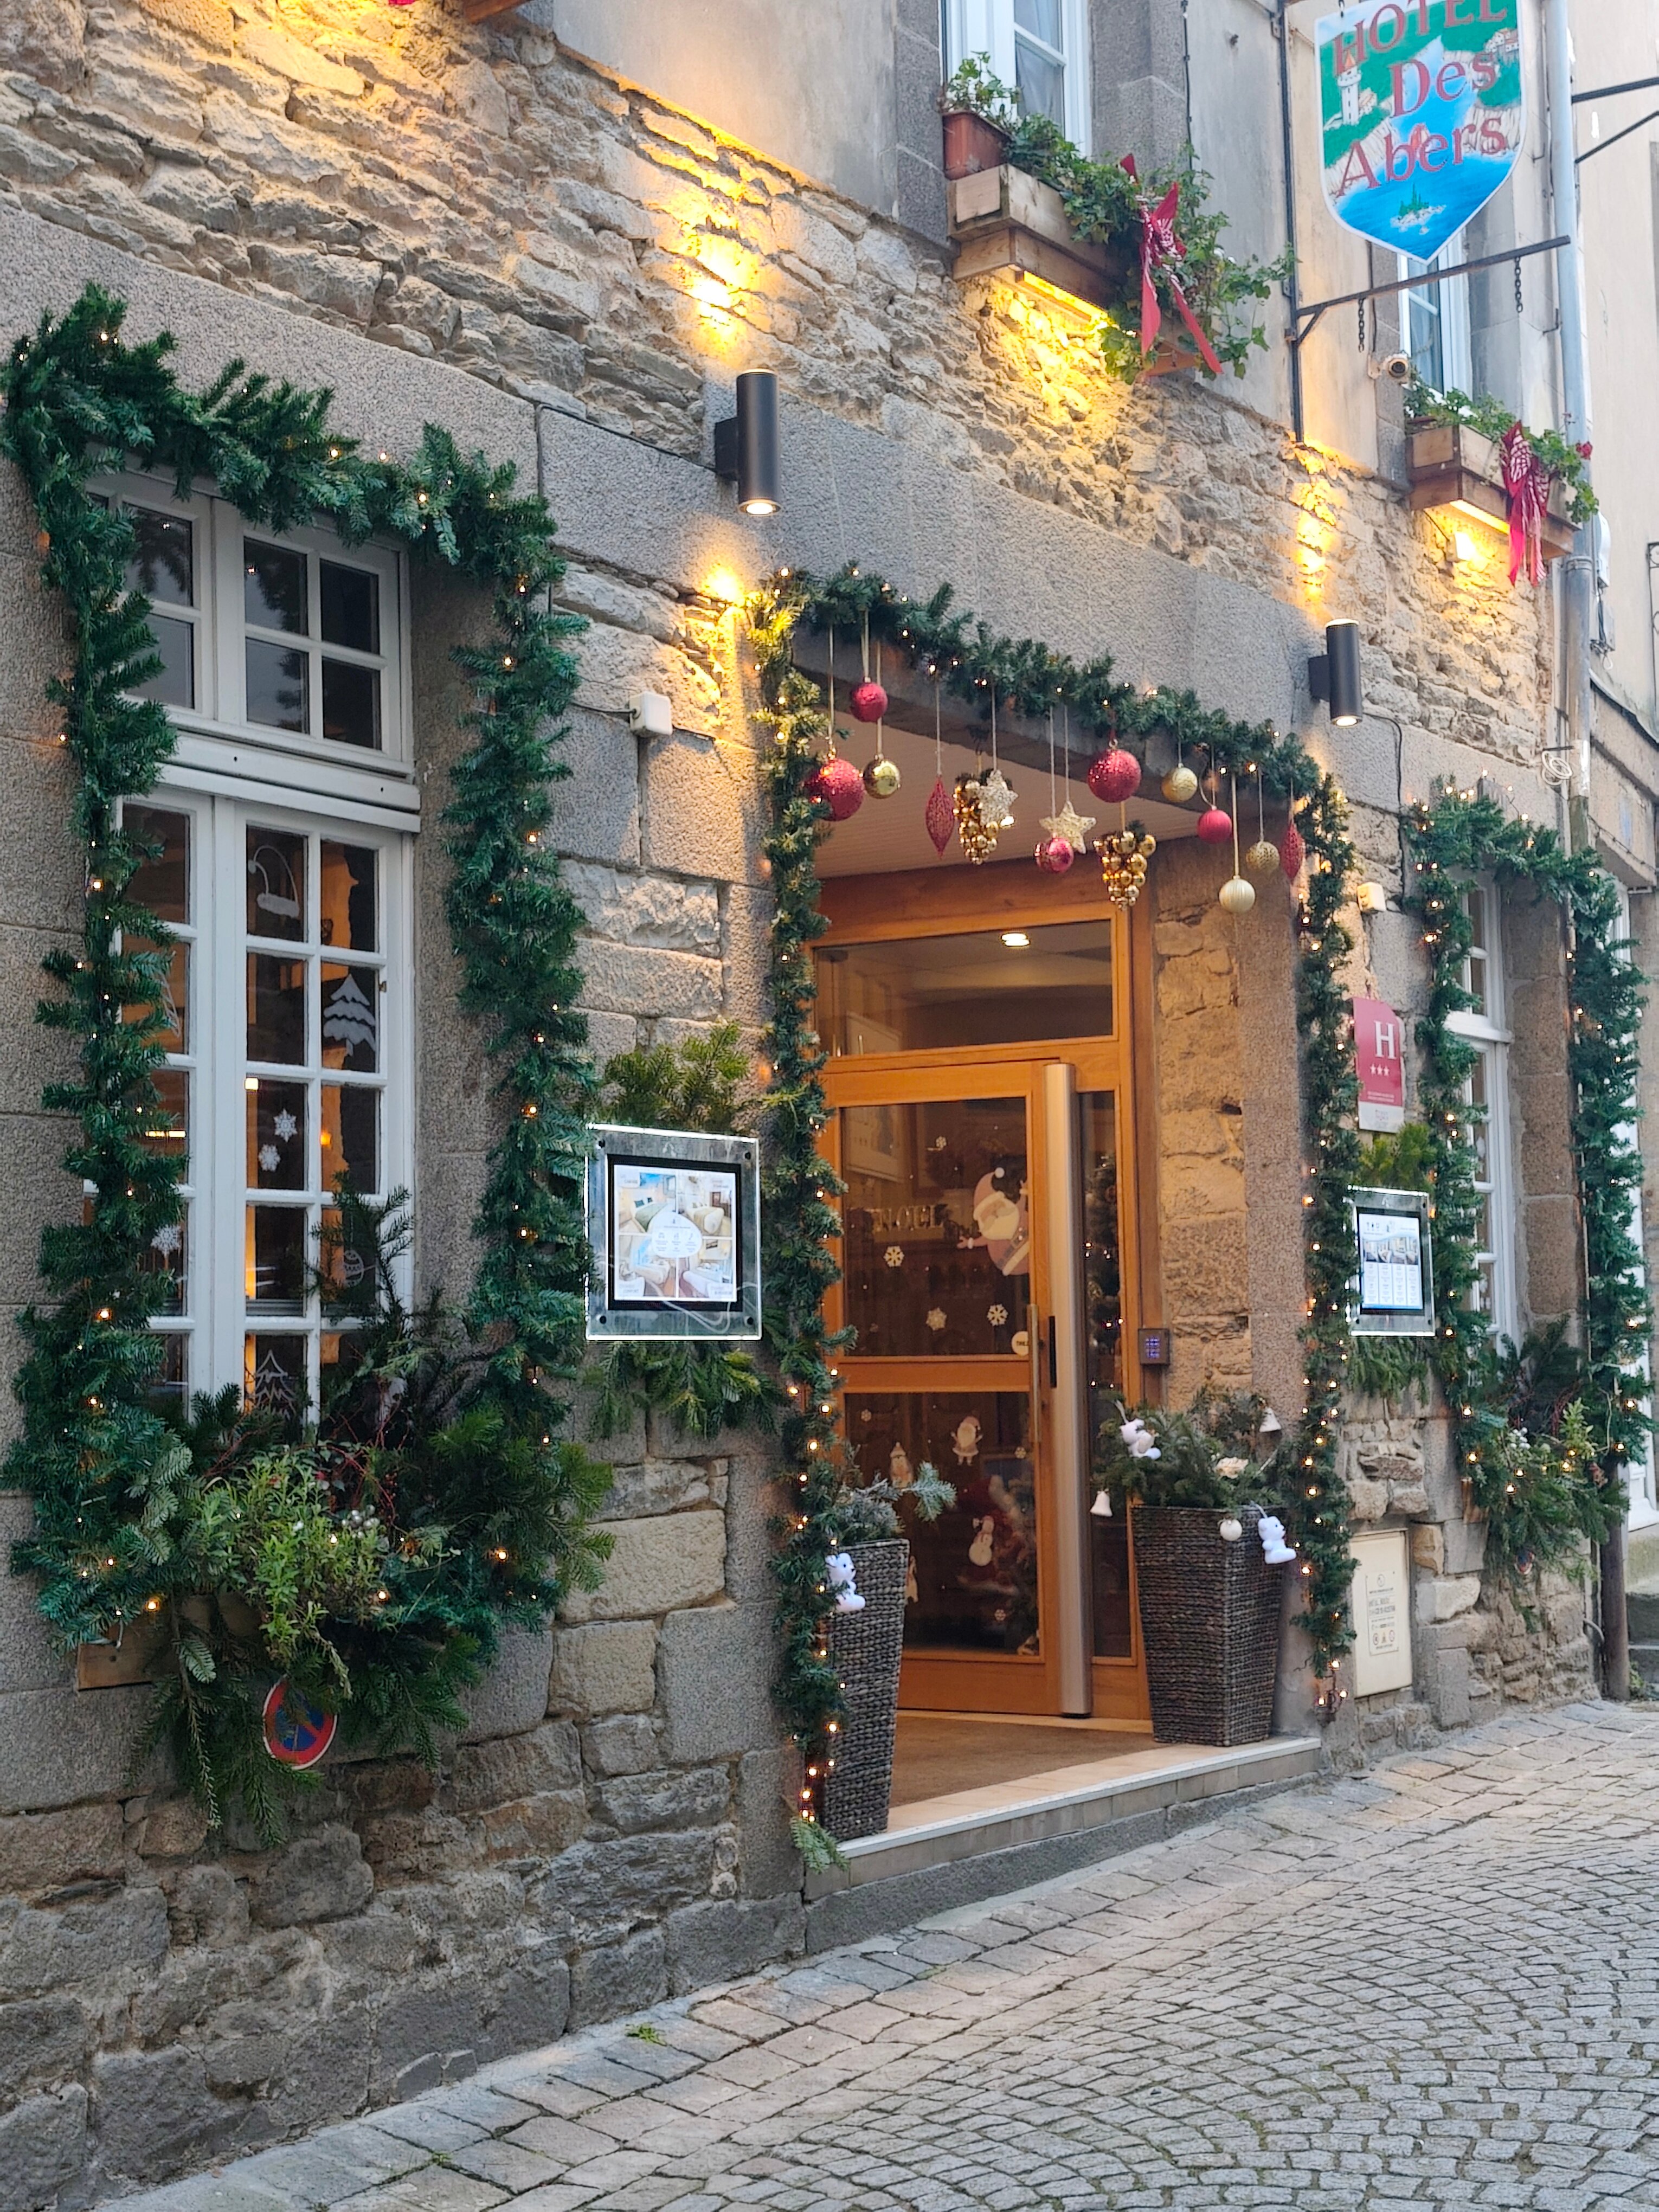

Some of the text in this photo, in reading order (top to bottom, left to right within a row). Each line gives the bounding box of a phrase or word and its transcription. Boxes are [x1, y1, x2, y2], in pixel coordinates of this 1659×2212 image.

[1389, 53, 1496, 118] Des
[1336, 119, 1507, 196] Abers
[1374, 1020, 1396, 1059] H
